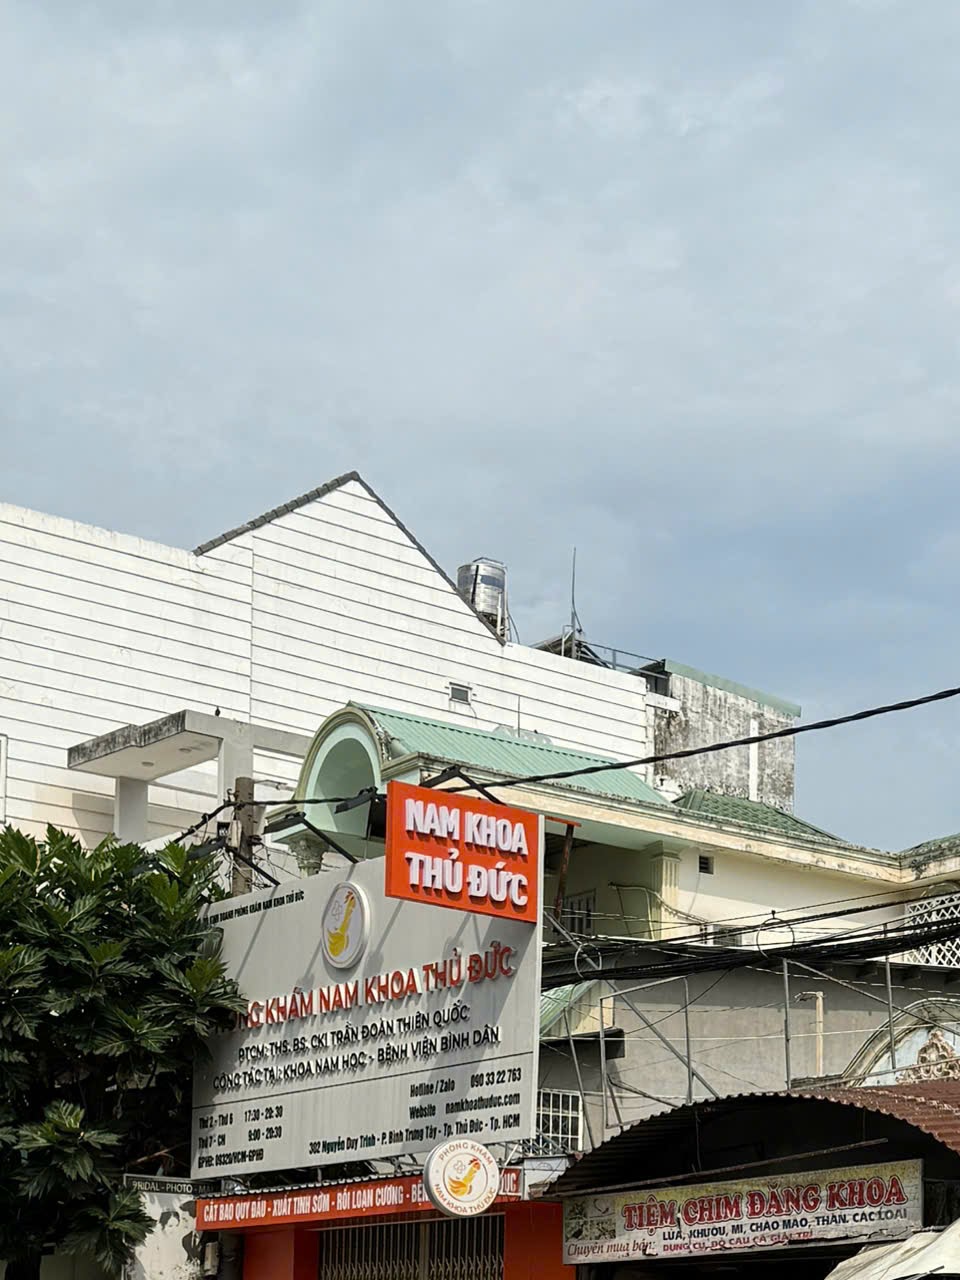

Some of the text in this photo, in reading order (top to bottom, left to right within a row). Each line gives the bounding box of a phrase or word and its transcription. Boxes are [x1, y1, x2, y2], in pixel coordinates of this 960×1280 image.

[405, 798, 529, 856] NAM KHOA
[404, 847, 529, 906] THỦ ĐỨC
[265, 986, 314, 1025] KHÁM
[319, 979, 360, 1014] NAM
[365, 968, 420, 1004] KHOA
[422, 947, 463, 991] THỦ
[467, 940, 514, 983] ĐỨC
[269, 1040, 291, 1057] THS.
[293, 1037, 308, 1053] BS.
[330, 1021, 358, 1045] TRẦN
[361, 1019, 394, 1040] ĐOÀN
[396, 1011, 430, 1033] THIÊN
[433, 999, 470, 1026] QUỐC
[283, 1060, 314, 1079] KHOA
[315, 1055, 340, 1074] NAM
[342, 1051, 367, 1071] HỌC
[378, 1042, 408, 1066] BỆNH
[411, 1036, 437, 1060] VIỆN
[440, 1028, 470, 1051] BÌNH
[472, 1024, 500, 1046] DÂN
[470, 1073, 484, 1088] 090
[485, 1071, 495, 1086] 33
[496, 1069, 506, 1084] 22
[502, 1113, 520, 1129] HCM
[166, 1184, 193, 1193] PHOTO
[219, 1203, 234, 1221] BAO
[235, 1201, 250, 1222] QUY
[352, 1188, 374, 1211] LOẠN
[621, 1175, 909, 1236] TIỆM CHIM ĐĂNG KHOA
[567, 1242, 604, 1257] Chuyên
